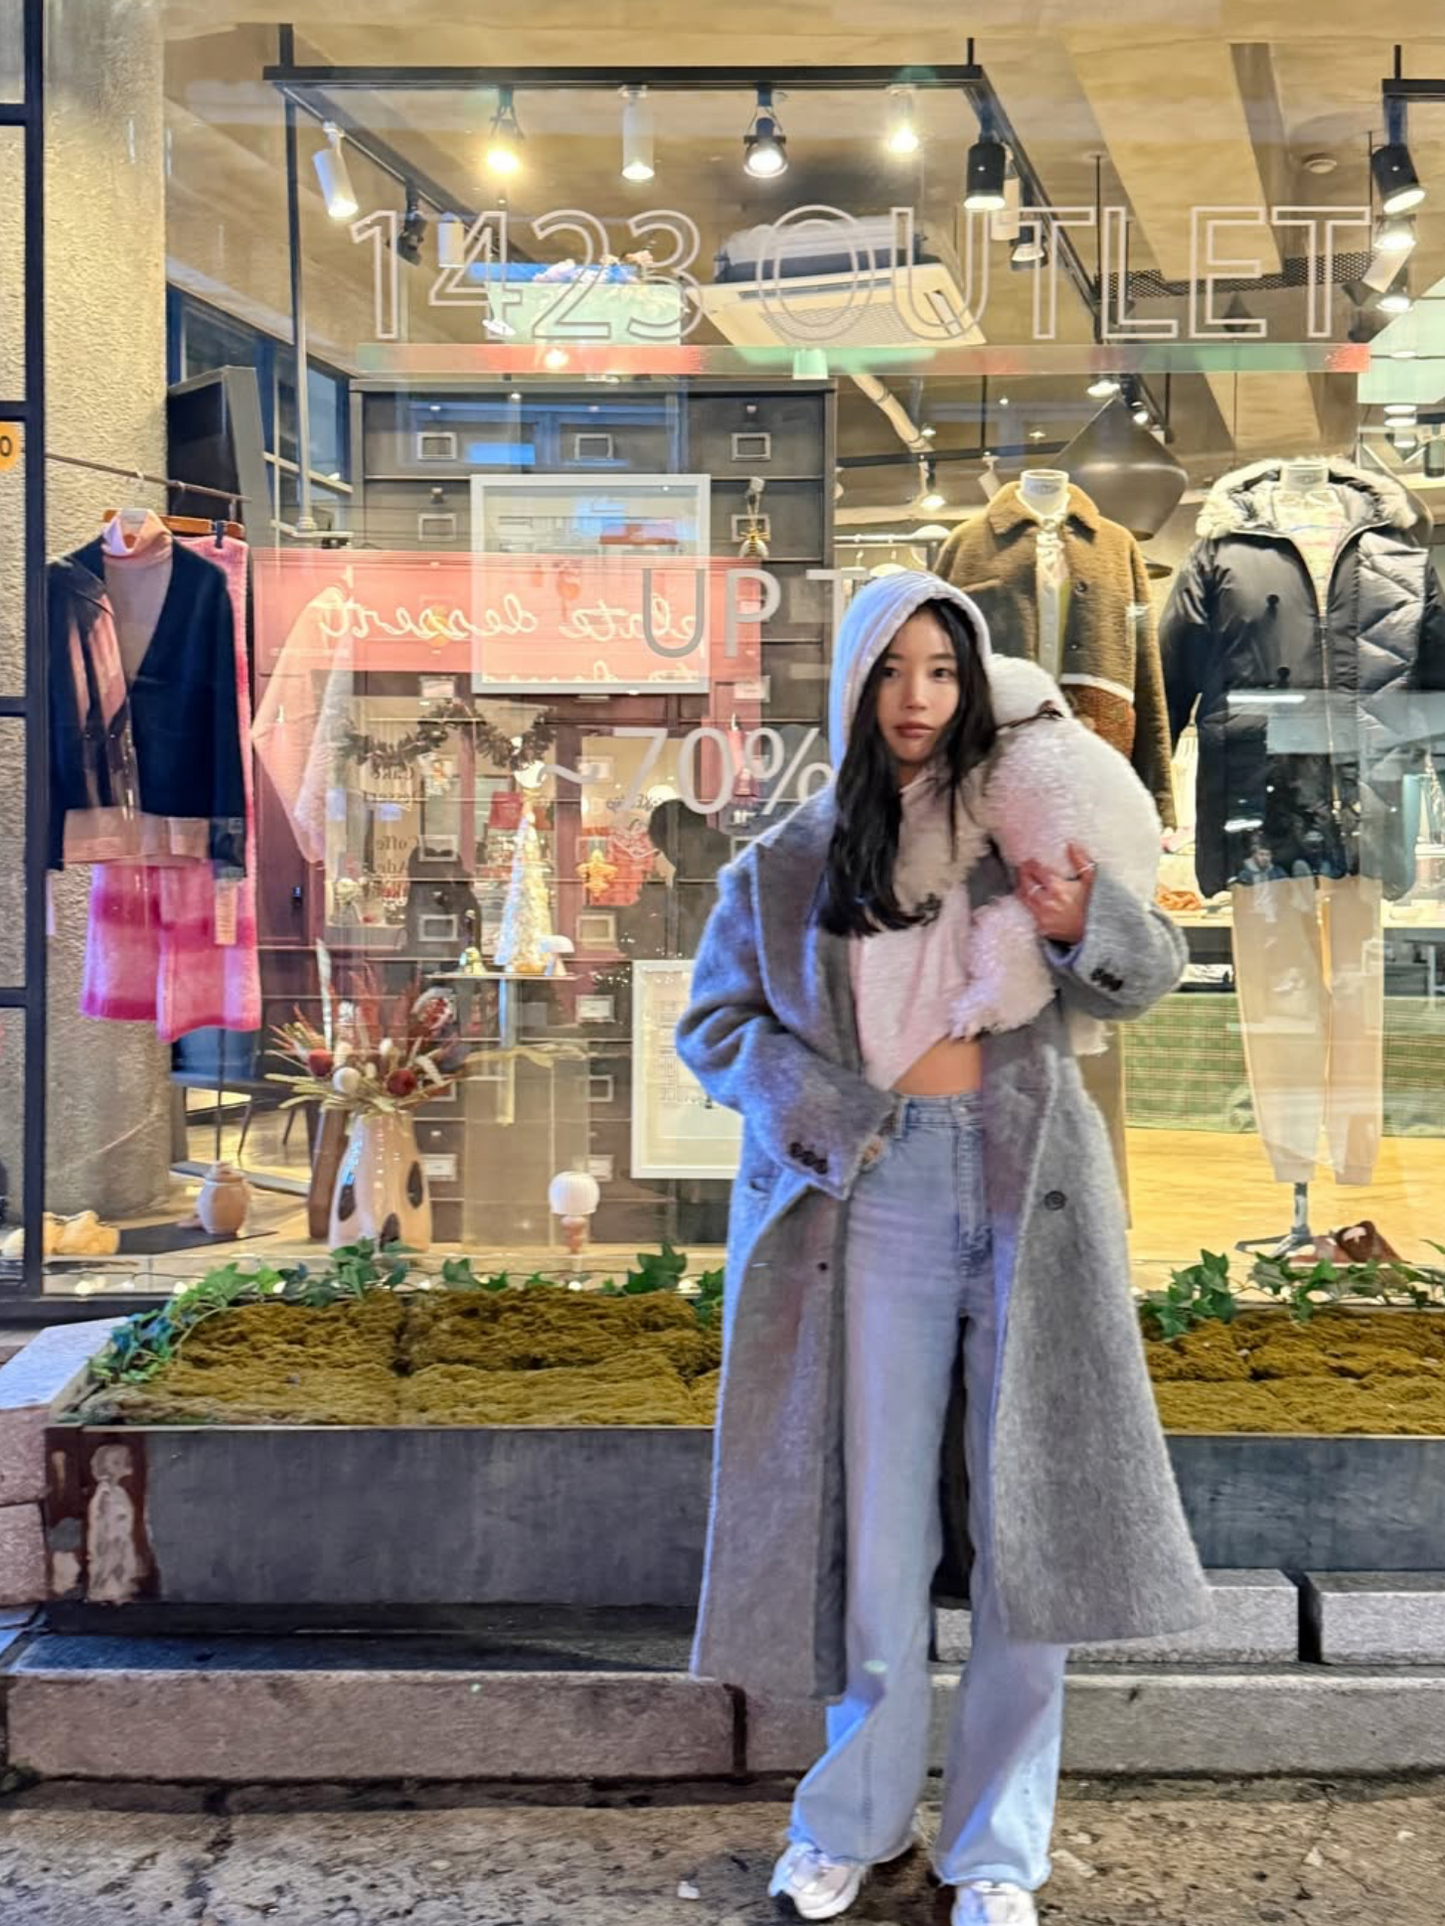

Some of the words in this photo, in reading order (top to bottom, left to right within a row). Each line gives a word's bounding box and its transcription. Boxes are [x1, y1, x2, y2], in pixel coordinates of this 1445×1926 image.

[351, 209, 701, 340] 1423
[756, 204, 1370, 340] OUTLET
[643, 569, 781, 658] UP
